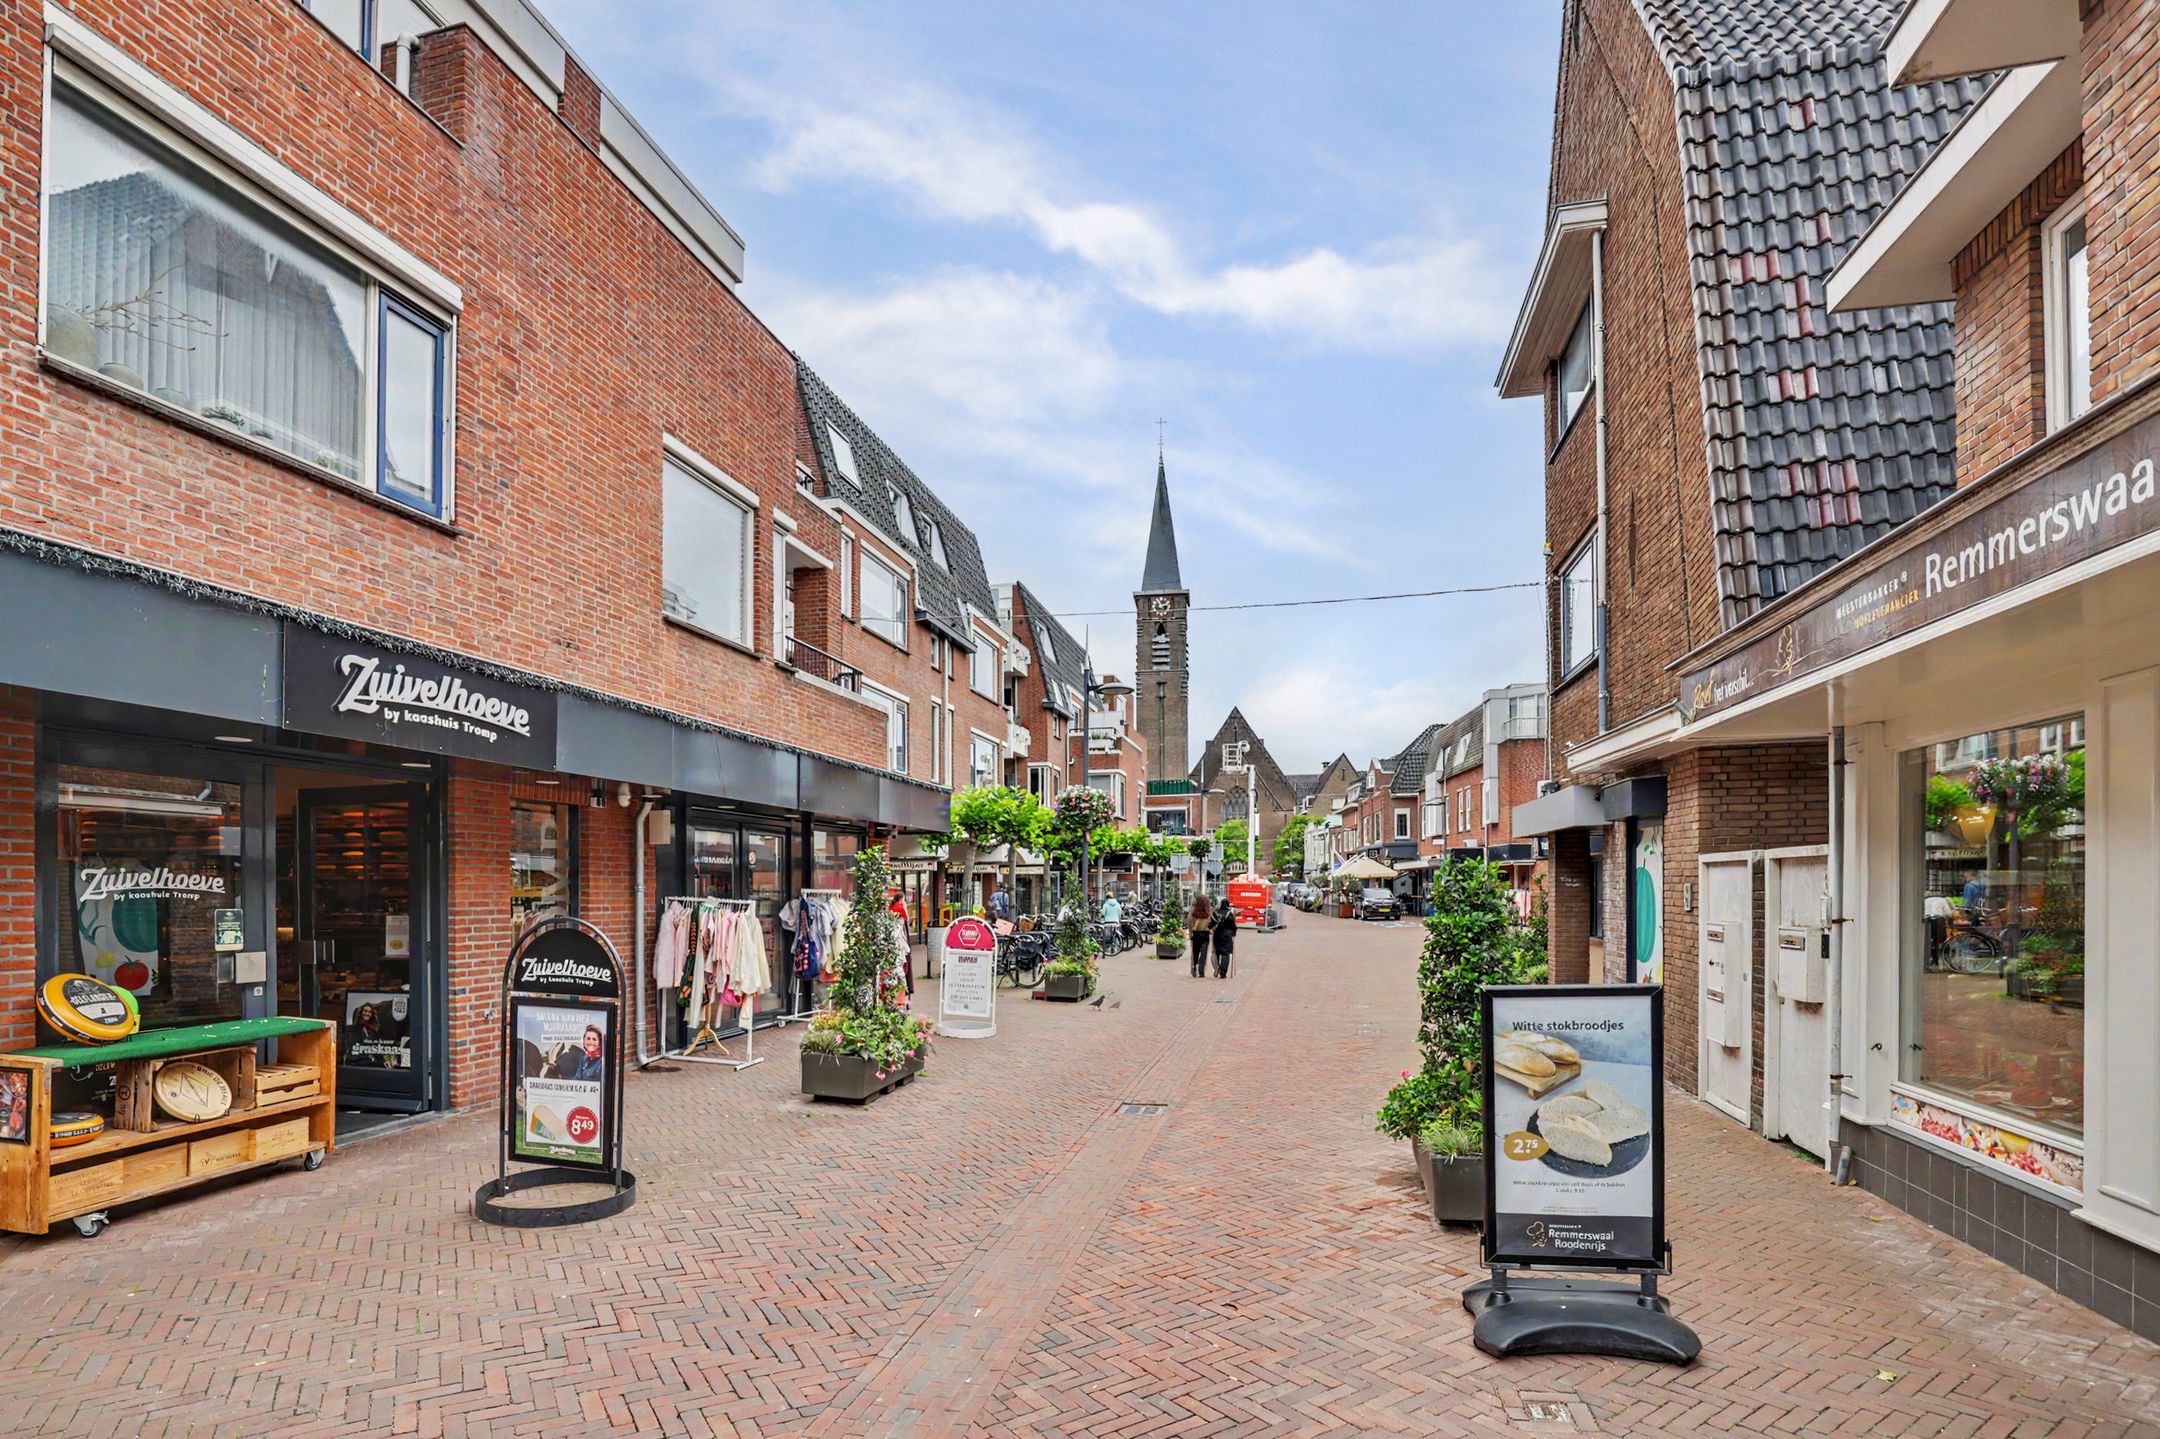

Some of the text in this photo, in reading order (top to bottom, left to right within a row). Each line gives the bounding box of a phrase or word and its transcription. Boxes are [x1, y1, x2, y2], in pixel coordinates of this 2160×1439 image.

[1926, 459, 2154, 598] Remmerswaa
[337, 654, 530, 737] Zuivelhoeve
[384, 707, 498, 743] by kaashuis Tromp
[80, 867, 226, 902] Zuivelhoeve
[113, 893, 125, 901] by
[521, 957, 612, 983] Zuivelhoeve
[1512, 1020, 1624, 1032] Witte stokbroodjes
[1548, 1229, 1614, 1240] Remmerswaal
[1555, 1239, 1606, 1251] Roodenrijs
